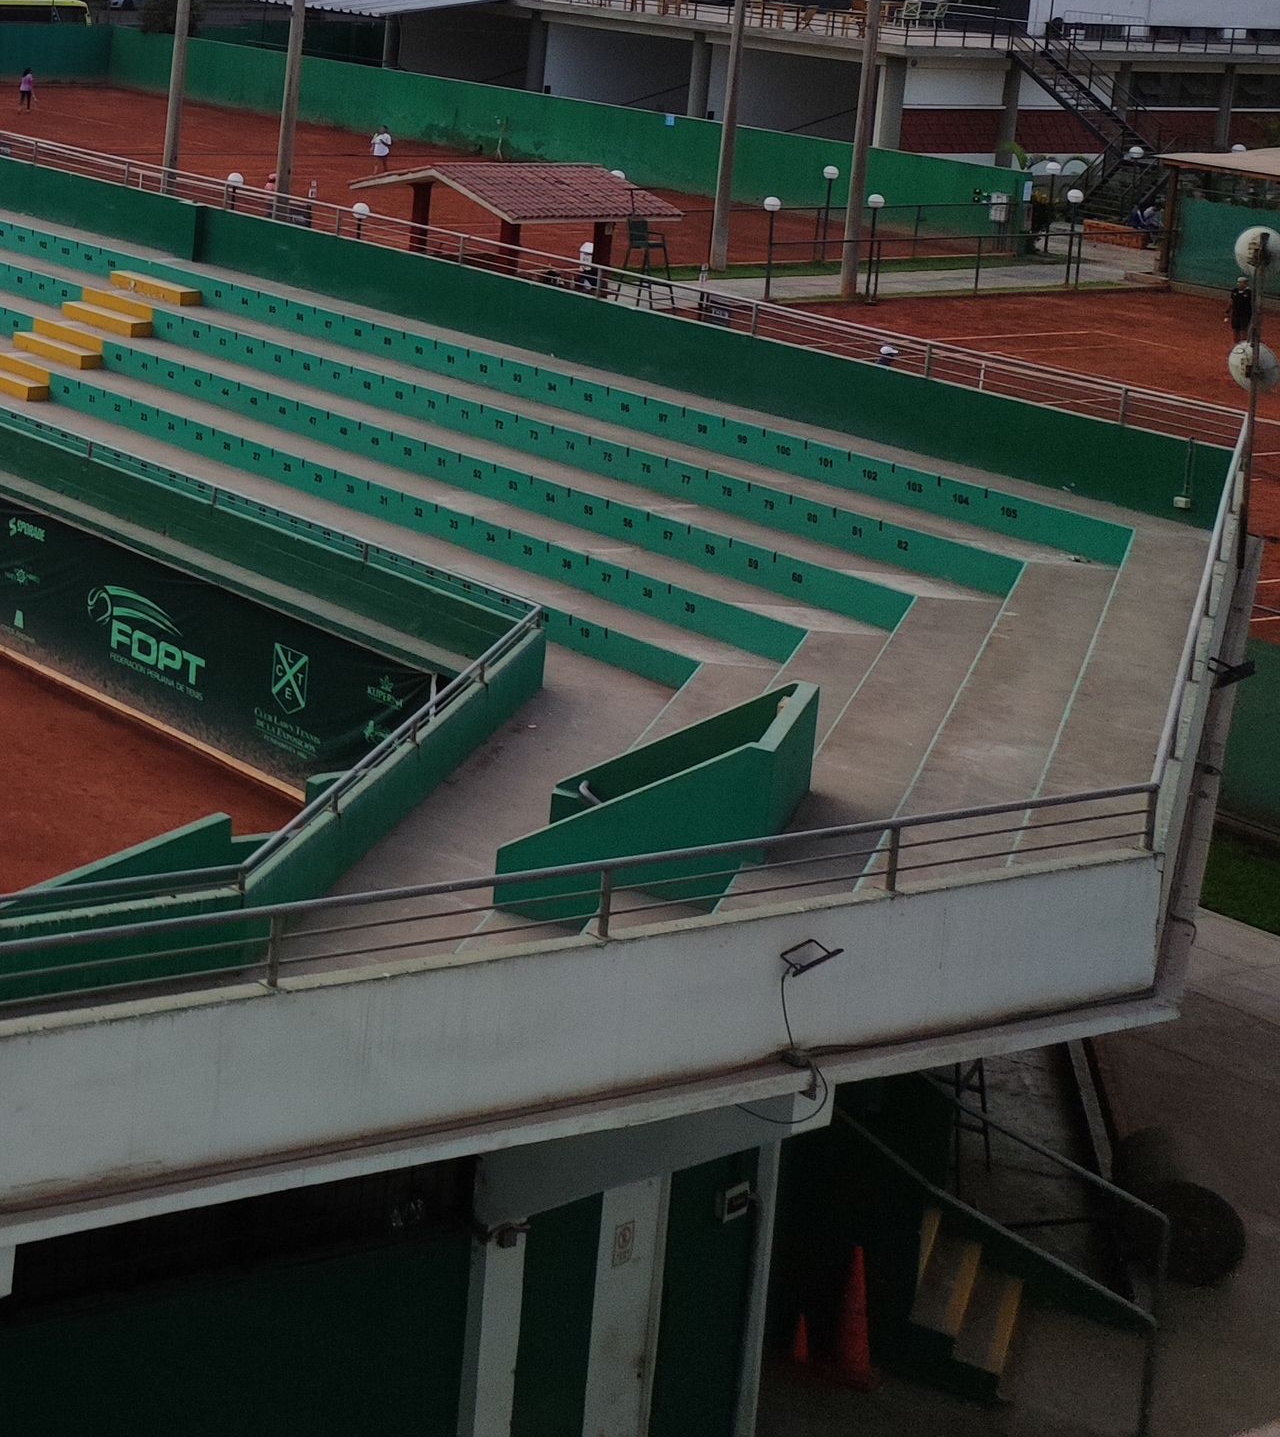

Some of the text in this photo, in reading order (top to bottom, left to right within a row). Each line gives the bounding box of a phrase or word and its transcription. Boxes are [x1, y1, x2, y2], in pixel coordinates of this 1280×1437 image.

[414, 345, 424, 356] 90
[512, 372, 522, 384] 93
[547, 382, 557, 393] 94
[583, 392, 593, 403] 95
[620, 402, 631, 413] 96
[658, 412, 669, 424] 97
[697, 423, 708, 435] 98
[737, 434, 748, 445] 99
[775, 444, 792, 457] 100
[818, 456, 833, 469] 101
[862, 468, 878, 482] 102
[906, 480, 924, 494] 103
[952, 493, 970, 506] 104
[1000, 505, 1018, 519] 105
[394, 390, 404, 401] 69
[460, 409, 470, 421] 71
[494, 419, 504, 430] 72
[529, 429, 539, 441] 73
[565, 440, 576, 451] 74
[602, 451, 613, 463] 75
[641, 462, 652, 474] 76
[680, 474, 692, 485] 77
[721, 485, 733, 498] 78
[763, 499, 775, 511] 79
[806, 512, 818, 524] 80
[851, 525, 863, 538] 81
[896, 539, 909, 552] 82
[313, 472, 323, 484] 29
[345, 483, 355, 495] 30
[413, 506, 424, 518] 32
[449, 518, 459, 530] 33
[486, 531, 496, 543] 34
[522, 544, 533, 557] 35
[561, 558, 572, 570] 36
[601, 572, 612, 584] 37
[642, 587, 653, 599] 38
[684, 601, 696, 614] 39
[370, 436, 380, 447] 49
[403, 446, 413, 457] 50
[472, 468, 482, 480] 52
[508, 479, 518, 491] 53
[545, 492, 556, 504] 54
[583, 504, 594, 516] 55
[622, 517, 634, 529] 56
[663, 530, 674, 541] 57
[704, 543, 716, 556] 58
[747, 557, 759, 570] 59
[791, 571, 803, 584] 60
[110, 618, 207, 686] FDPT
[287, 651, 295, 664] L
[579, 626, 590, 639] 19
[275, 664, 304, 686] C T
[284, 686, 293, 701] E
